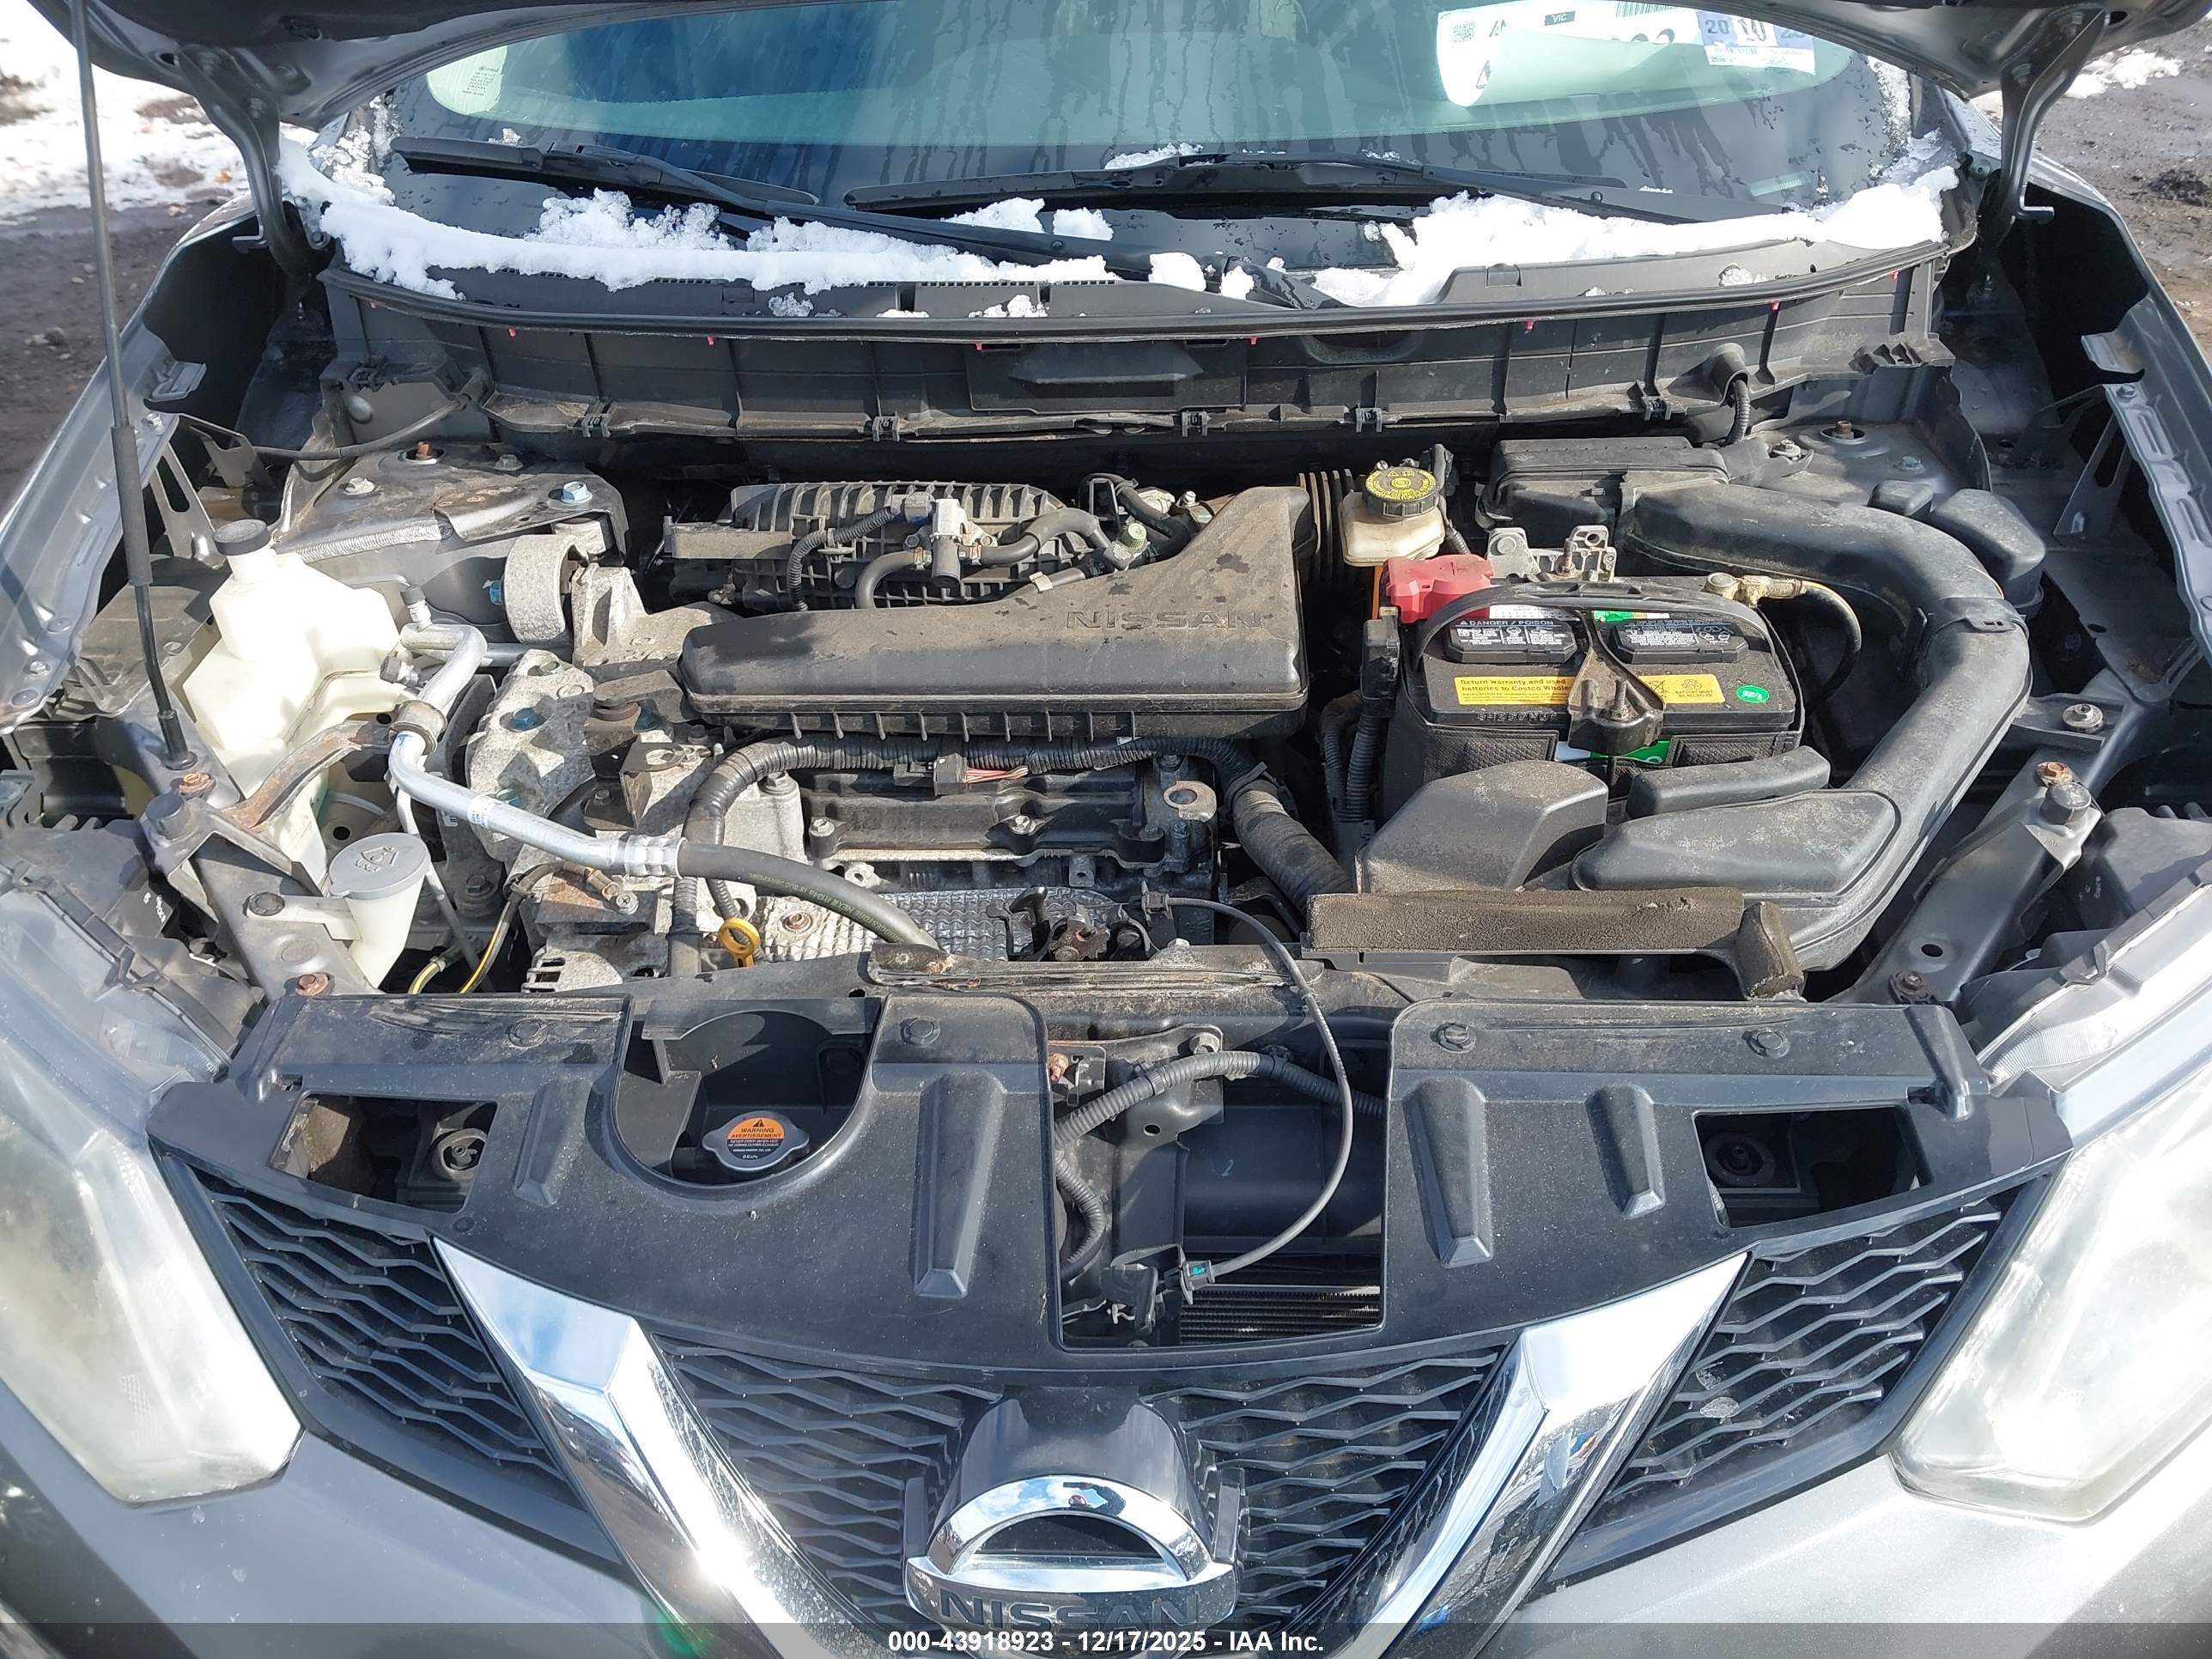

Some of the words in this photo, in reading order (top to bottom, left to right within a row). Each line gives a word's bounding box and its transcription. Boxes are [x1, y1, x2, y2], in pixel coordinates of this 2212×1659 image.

[1705, 19, 1730, 34] 20
[1066, 611, 1264, 629] NISSAN
[939, 1587, 1201, 1632] NISSAN
